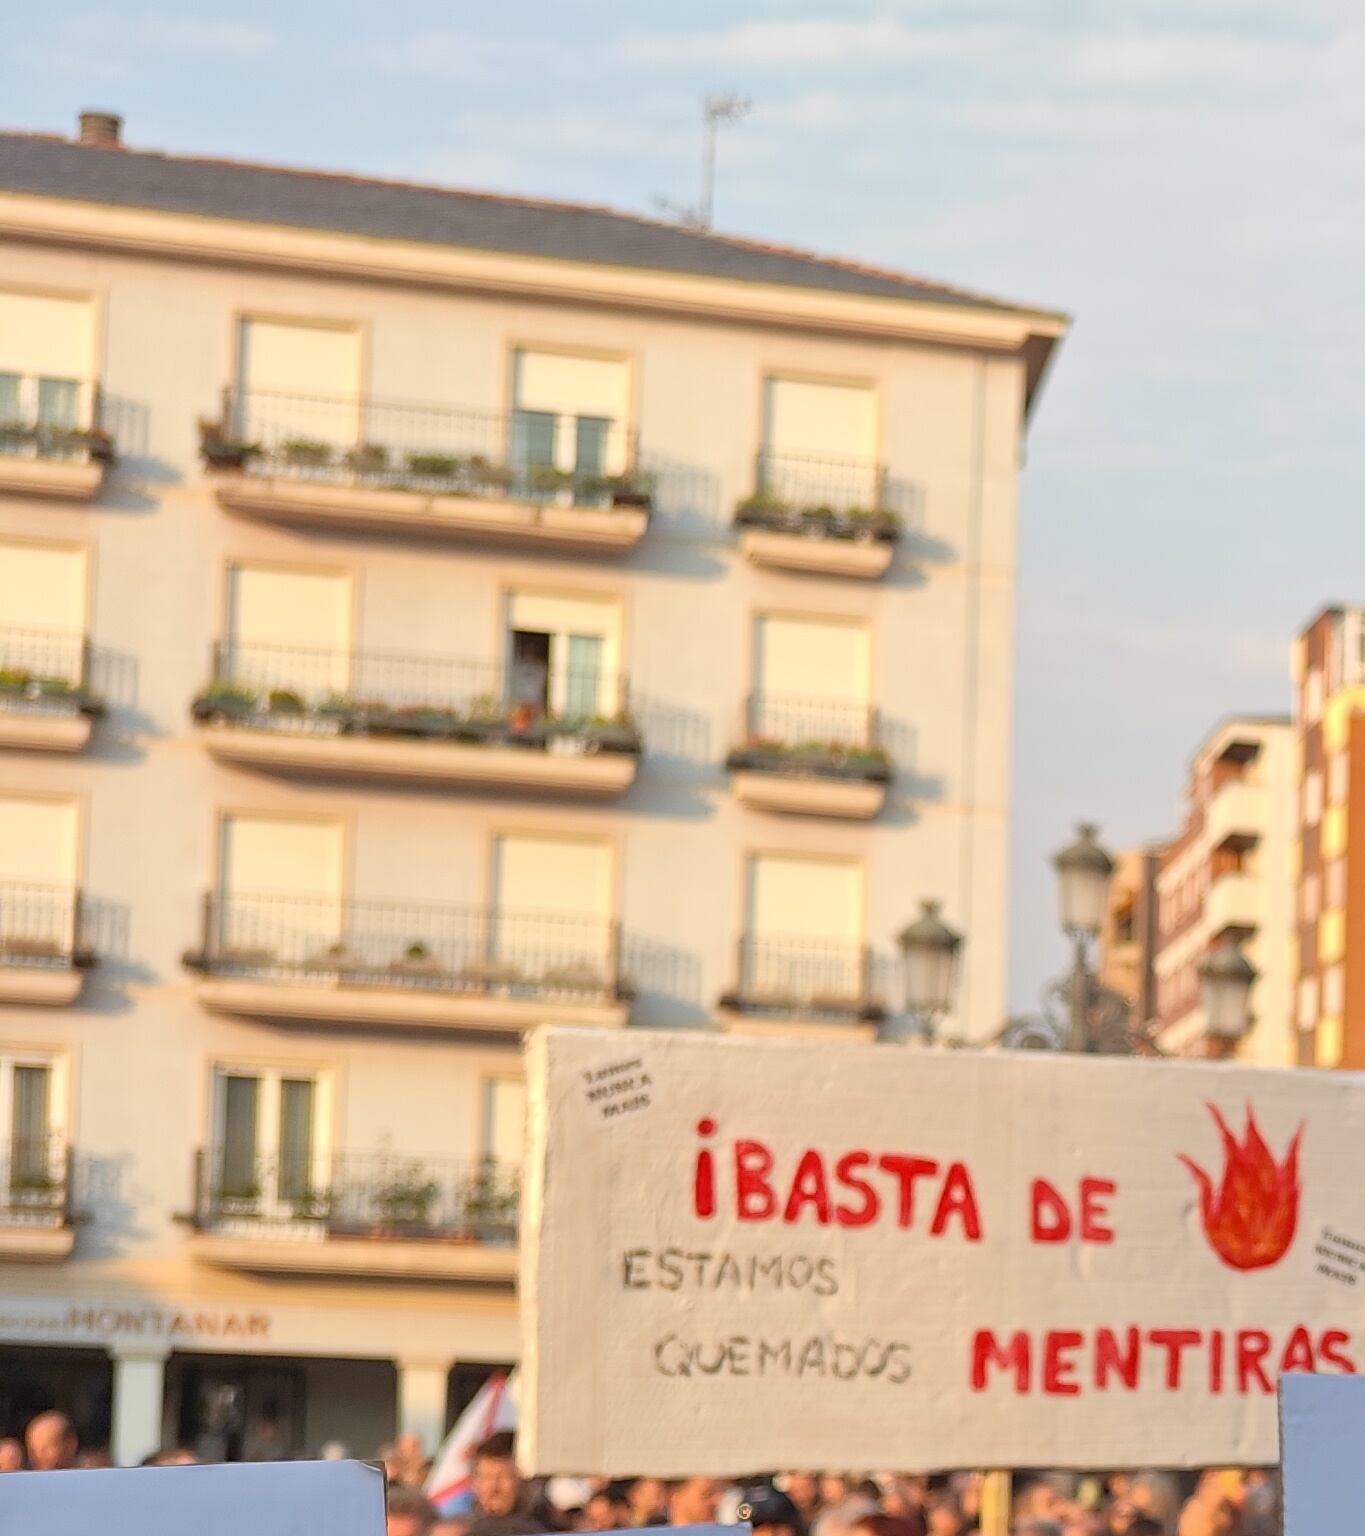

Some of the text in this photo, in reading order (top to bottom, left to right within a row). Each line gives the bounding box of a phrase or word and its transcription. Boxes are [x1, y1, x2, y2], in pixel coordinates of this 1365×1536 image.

[694, 1115, 1118, 1245] ¡BASTA DE
[621, 1247, 839, 1297] ESTAMOS
[654, 1333, 911, 1386] QUEMADOS
